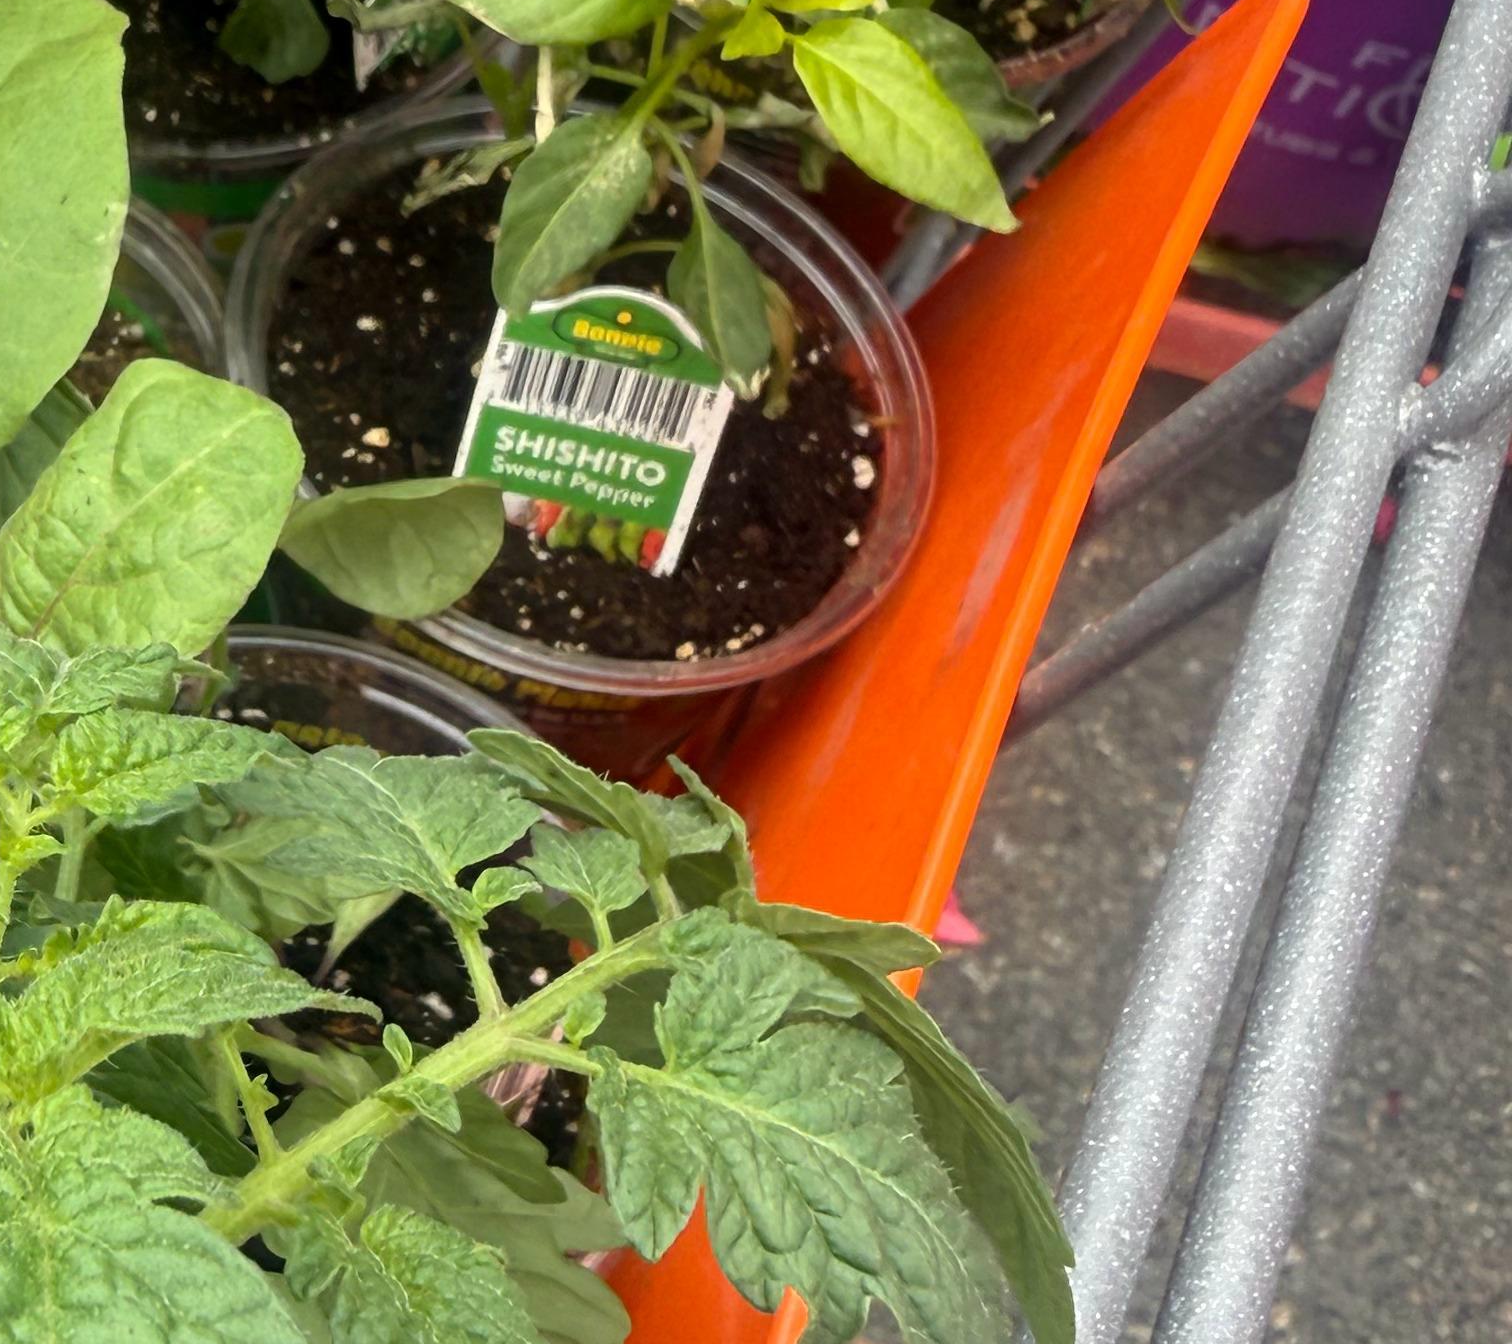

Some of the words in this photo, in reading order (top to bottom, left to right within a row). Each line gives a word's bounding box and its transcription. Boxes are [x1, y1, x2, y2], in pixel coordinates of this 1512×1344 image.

[491, 456, 563, 487] Sweet
[570, 472, 656, 508] Pepper
[495, 425, 666, 487] SHISHITO
